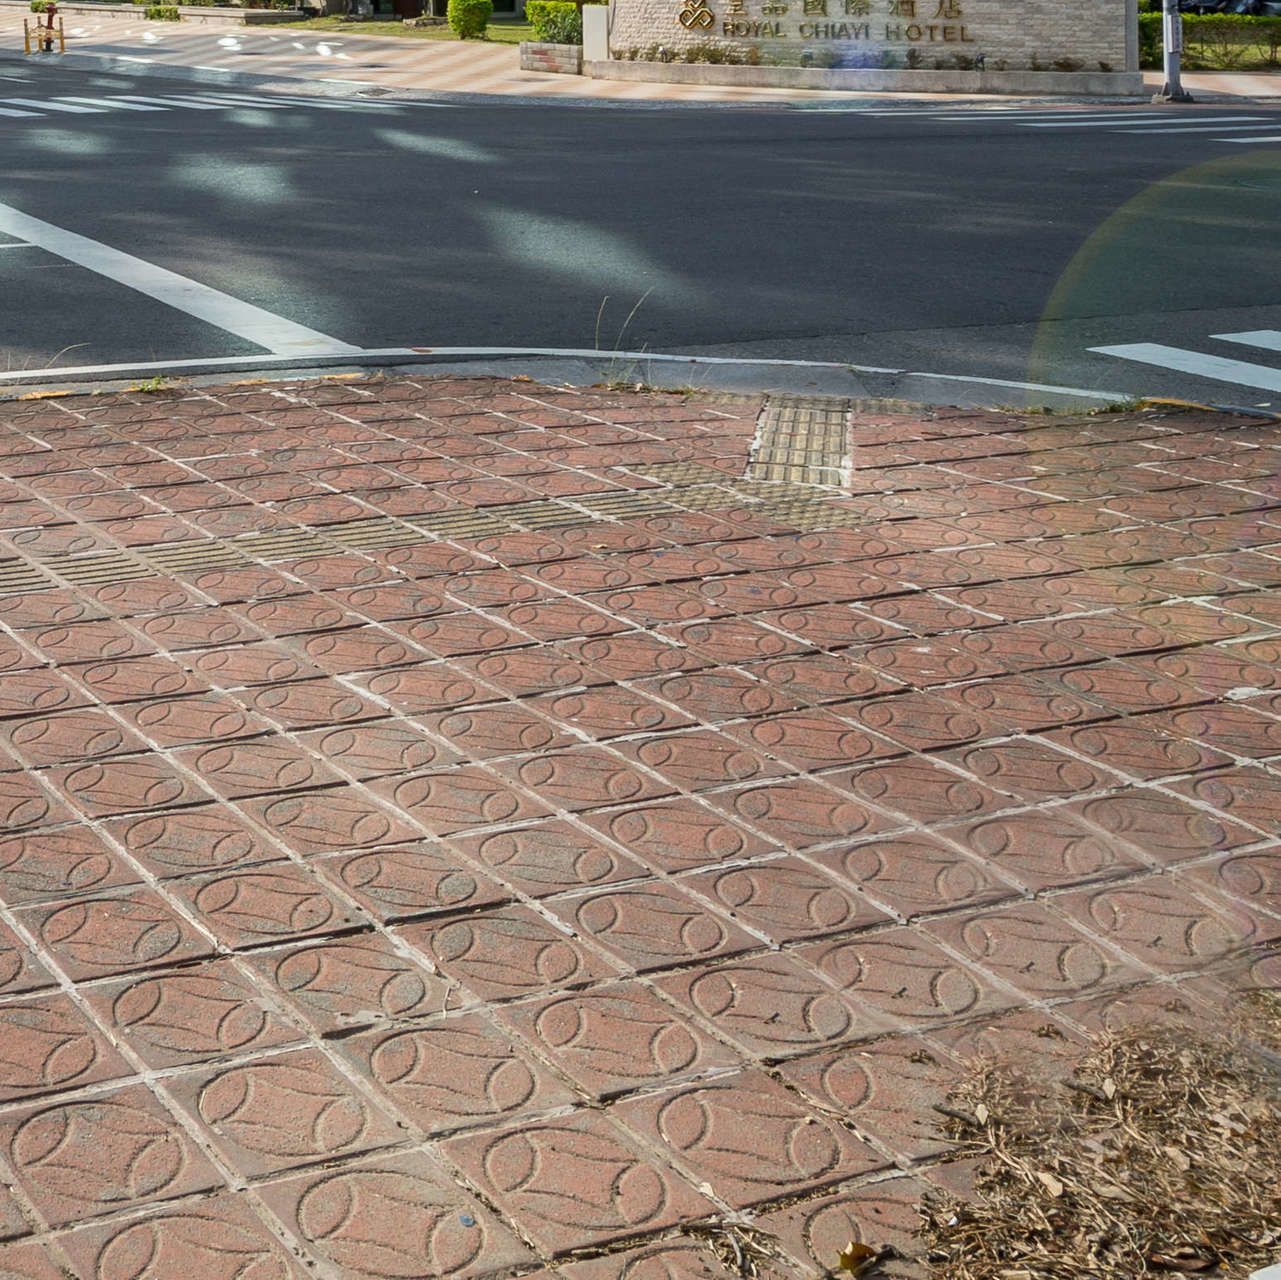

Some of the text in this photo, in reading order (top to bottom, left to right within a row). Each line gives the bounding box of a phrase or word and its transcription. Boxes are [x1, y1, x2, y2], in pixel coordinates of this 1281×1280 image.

[723, 19, 974, 42] ROYAL CHIAYI HOTEL
